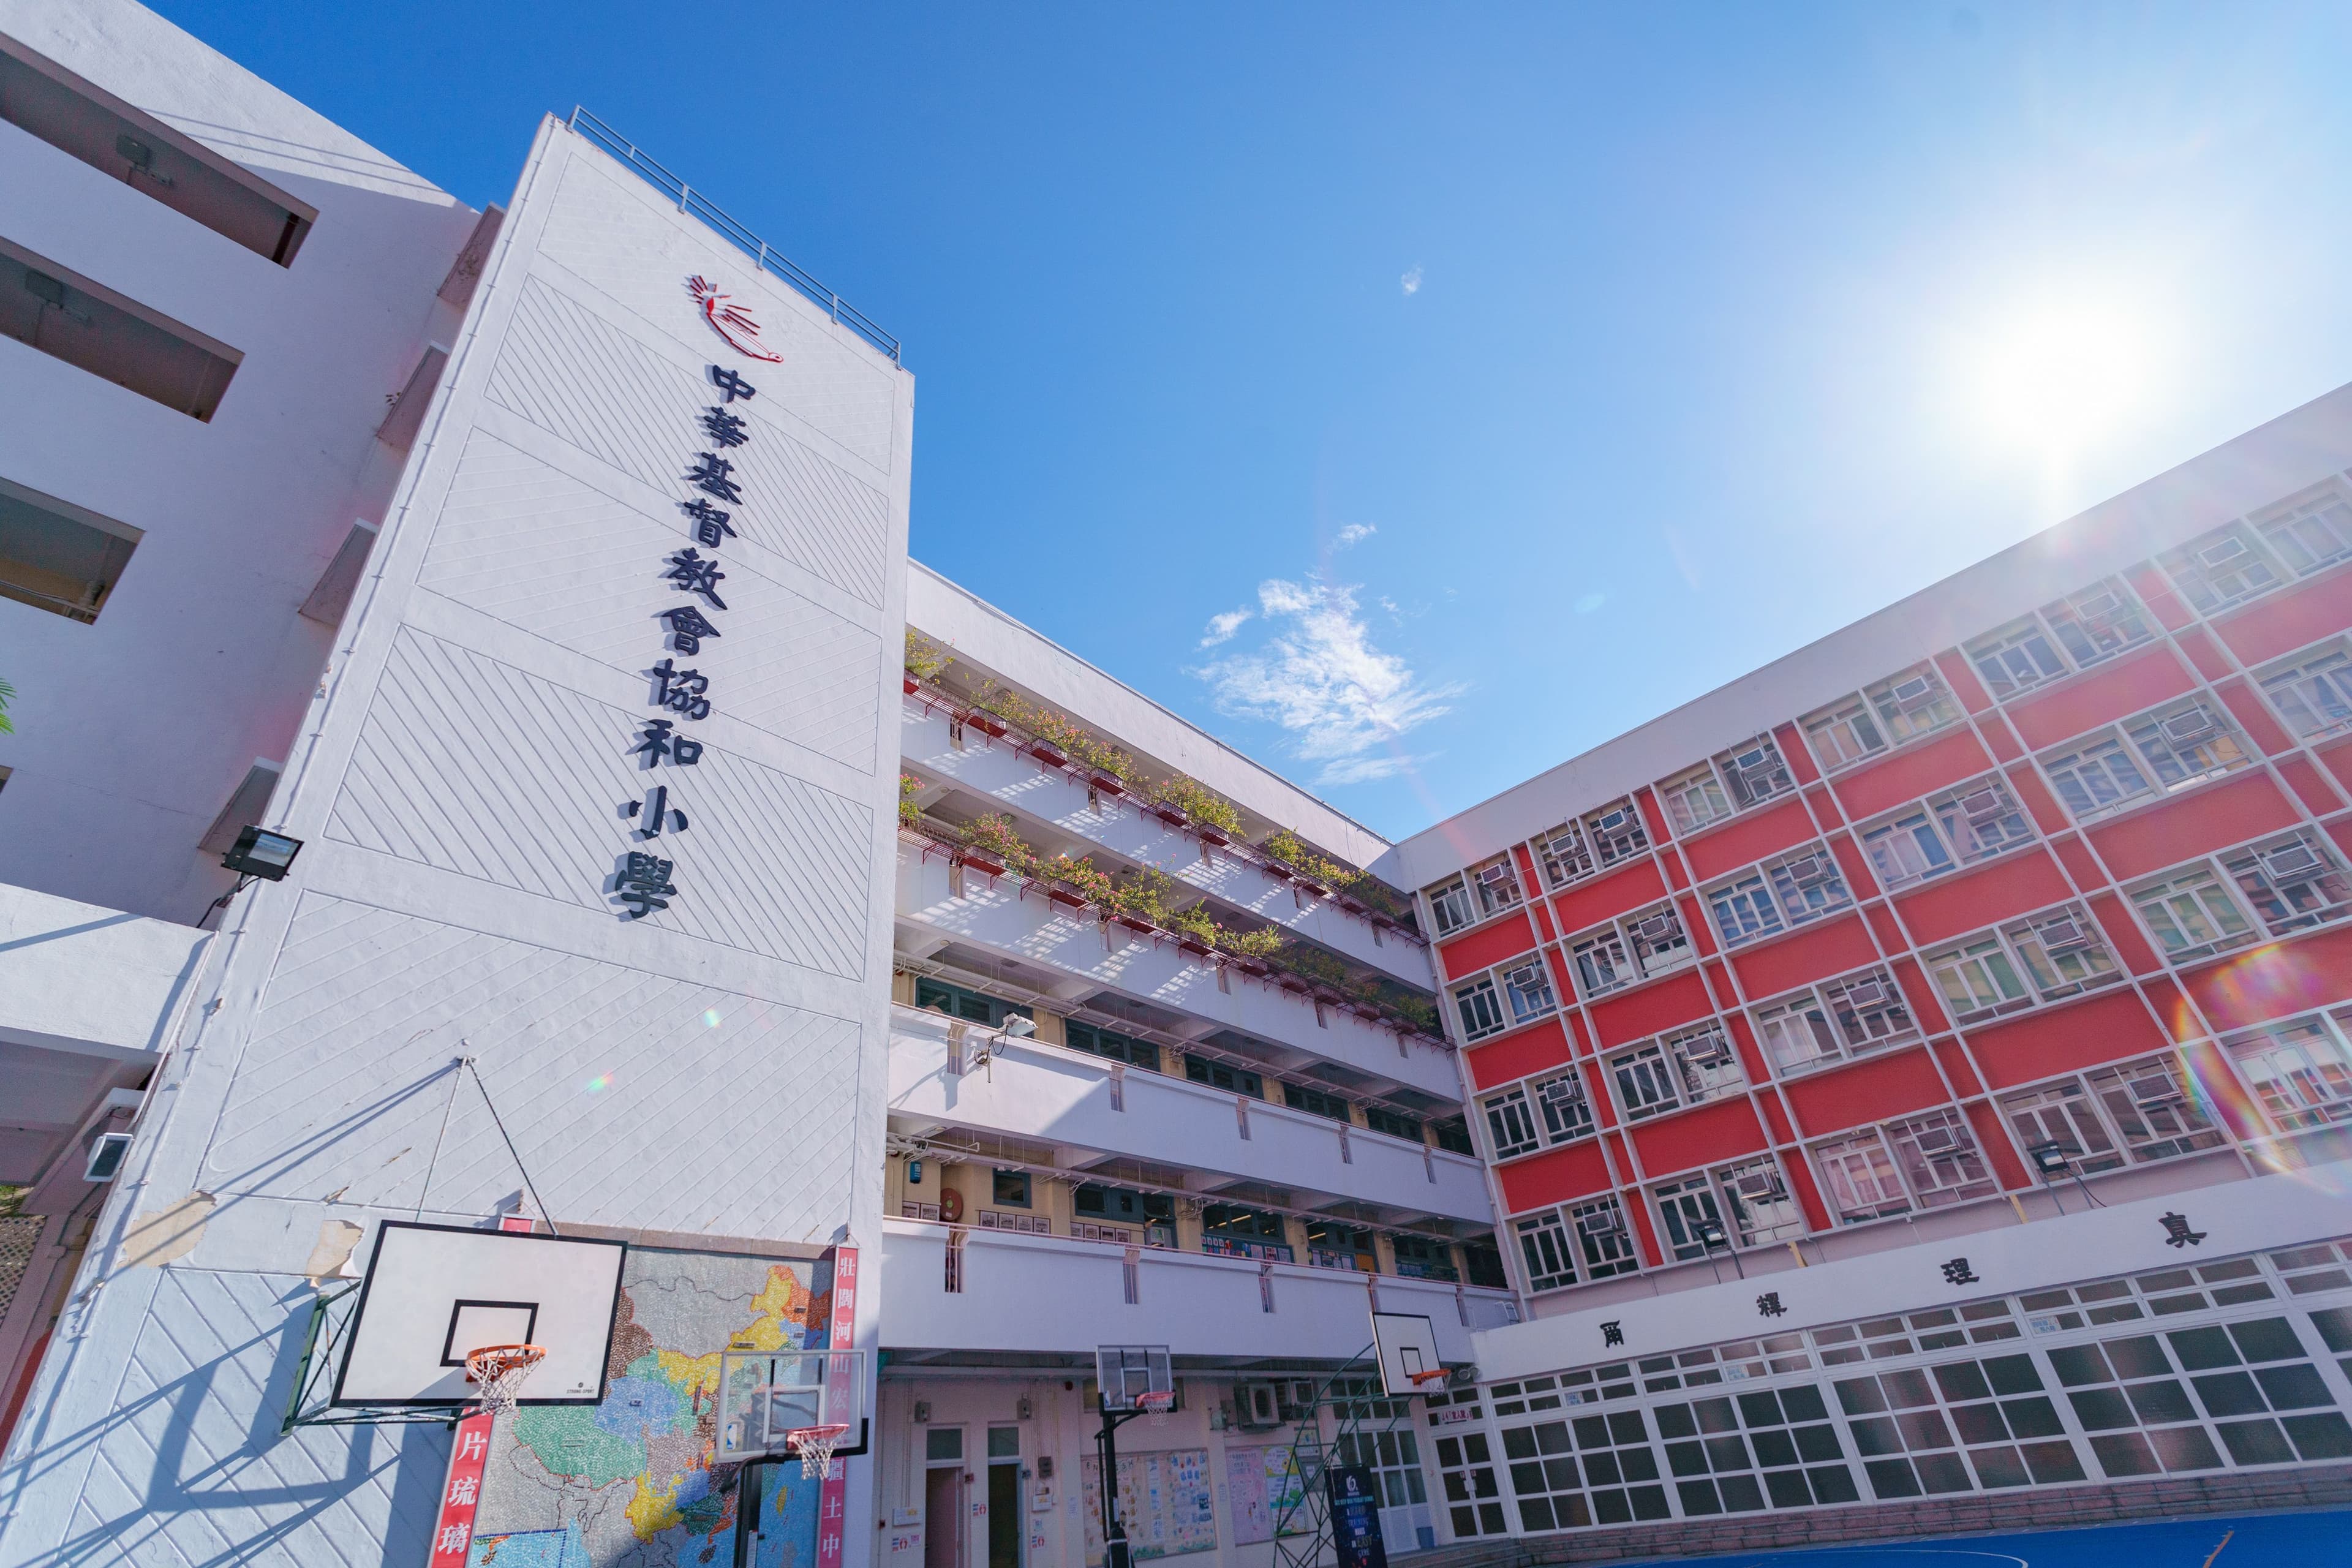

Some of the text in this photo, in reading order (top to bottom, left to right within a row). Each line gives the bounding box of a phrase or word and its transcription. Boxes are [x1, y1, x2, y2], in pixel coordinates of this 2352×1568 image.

[614, 364, 756, 919] 中華基督教會協和小學
[437, 1407, 494, 1555] 片琉璃
[823, 1256, 856, 1559] 壯闊河山宏疆土中
